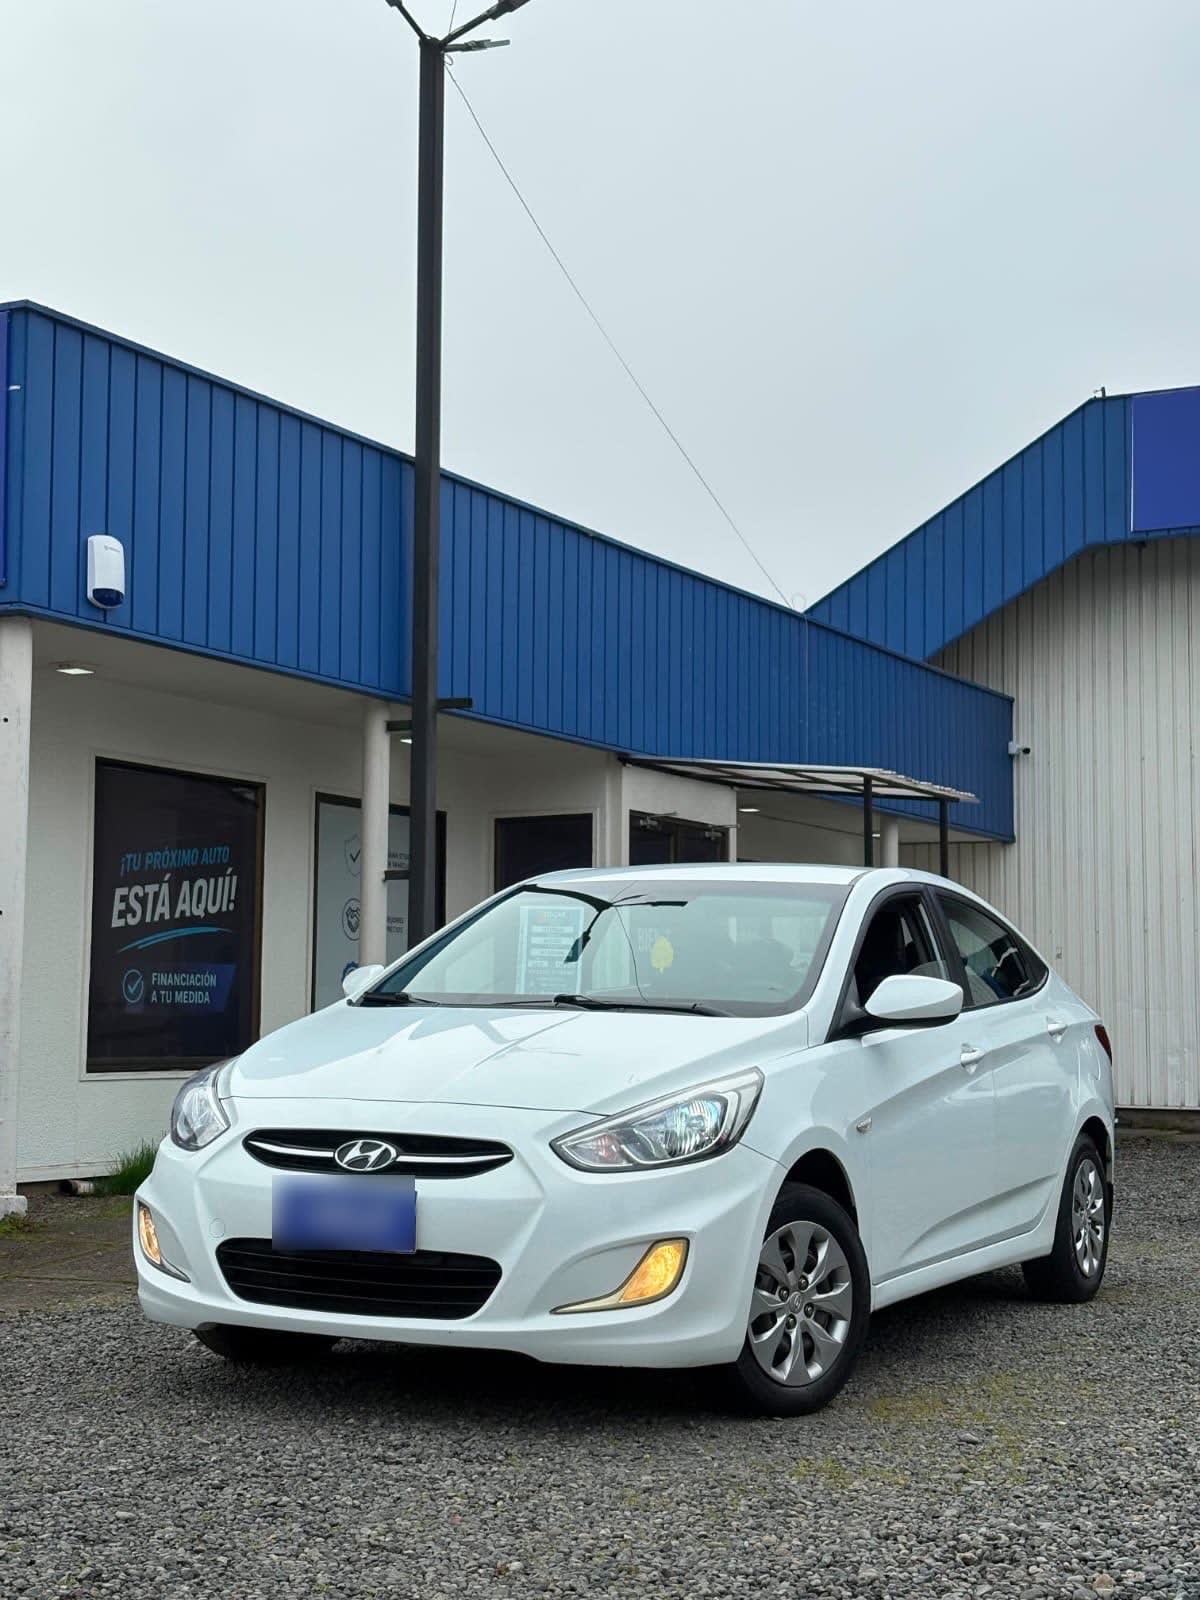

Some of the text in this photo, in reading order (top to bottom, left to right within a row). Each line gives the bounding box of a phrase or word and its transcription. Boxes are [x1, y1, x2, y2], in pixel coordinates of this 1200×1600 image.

[144, 846, 199, 870] PRÓXIMO
[201, 846, 230, 864] AUTO
[110, 866, 238, 928] ESTÁ AQUÍ!
[151, 971, 217, 987] FINANCIACIÓN
[151, 990, 210, 1005] A TU MEDIDA
